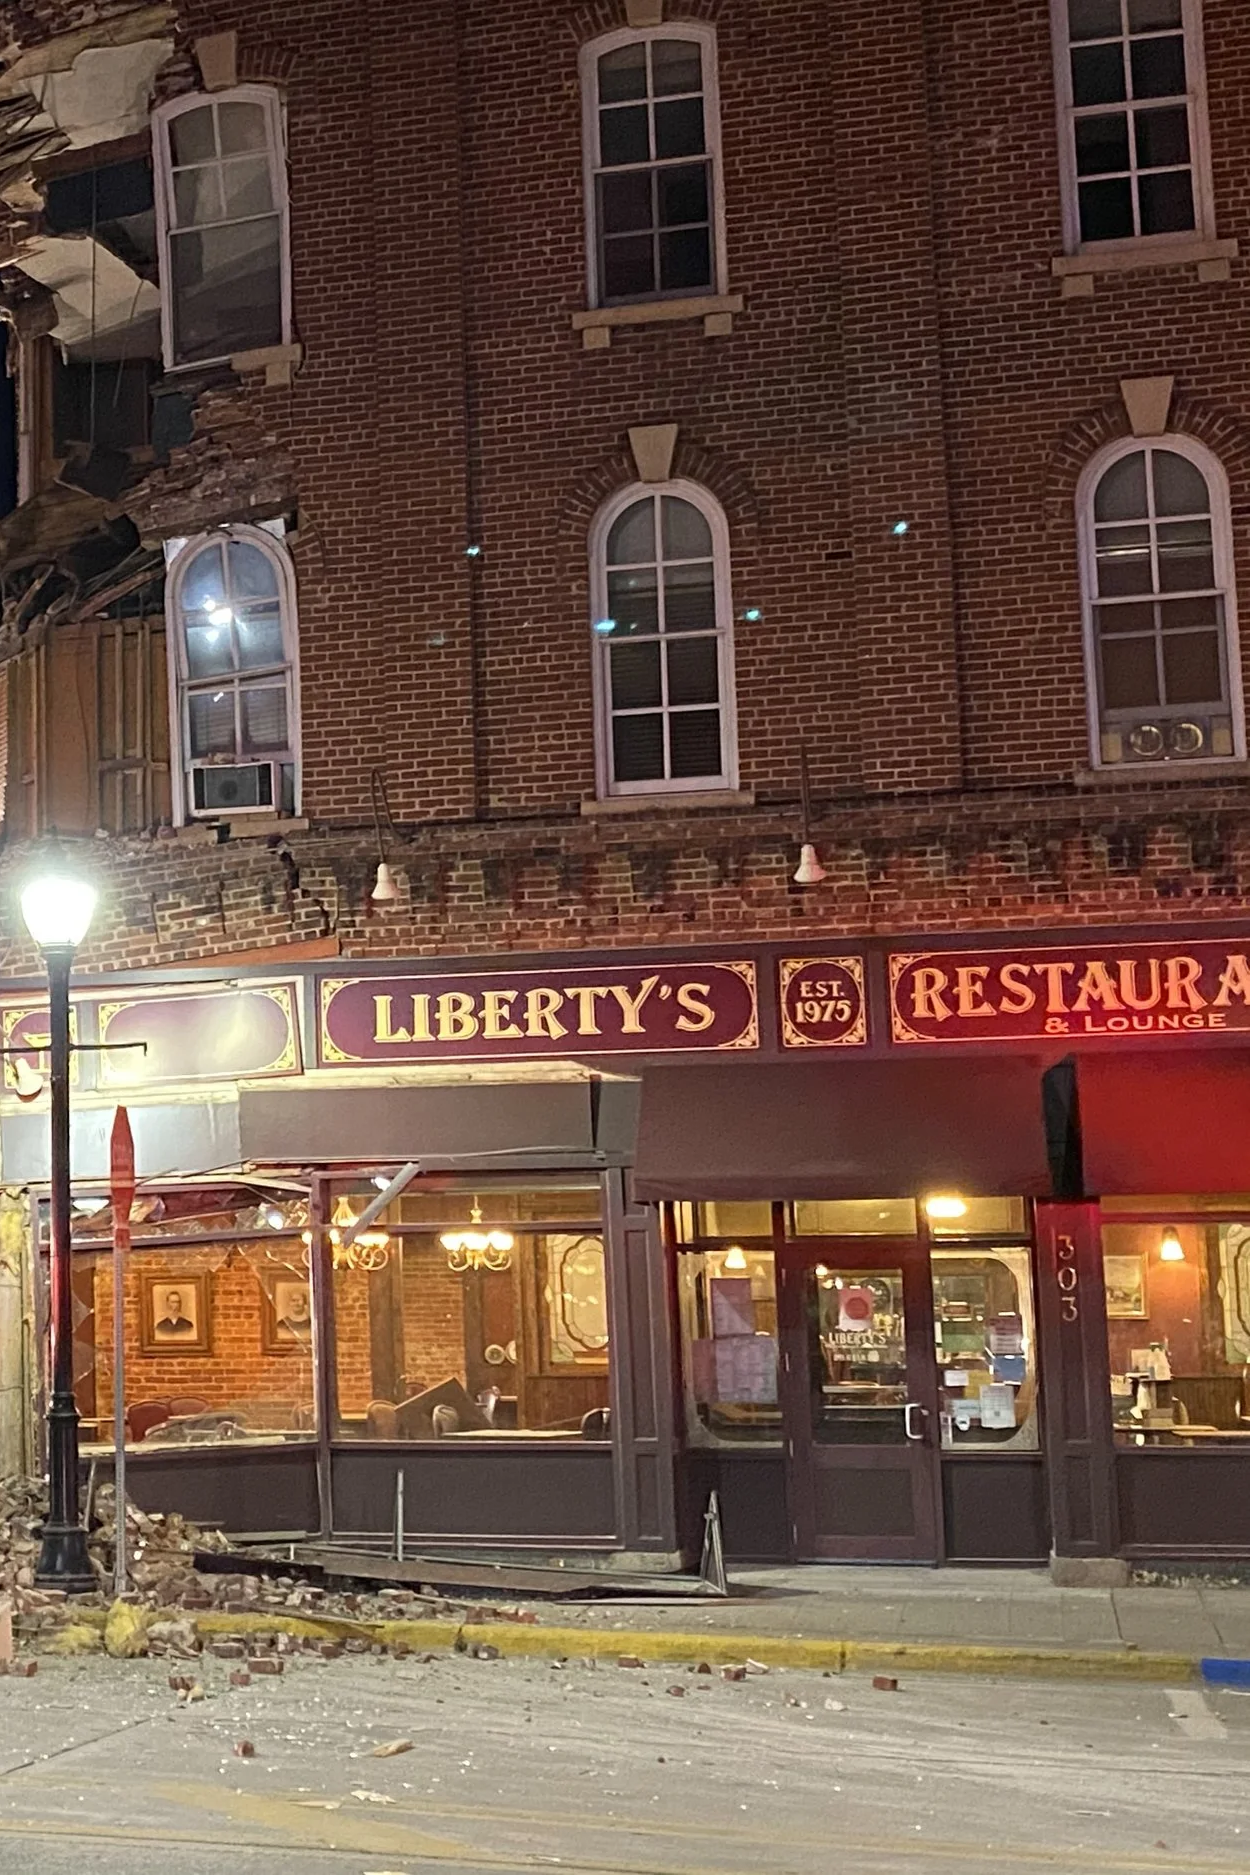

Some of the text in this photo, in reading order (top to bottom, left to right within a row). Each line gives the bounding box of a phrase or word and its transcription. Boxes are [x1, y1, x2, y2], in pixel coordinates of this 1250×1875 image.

[800, 981, 845, 998] EST.
[372, 975, 715, 1043] LIBERTY'S
[795, 1000, 851, 1024] 1975
[1044, 1013, 1227, 1034] & LOUNGE
[1057, 1235, 1078, 1322] 303
[829, 1329, 886, 1345] LIBERTY'S
